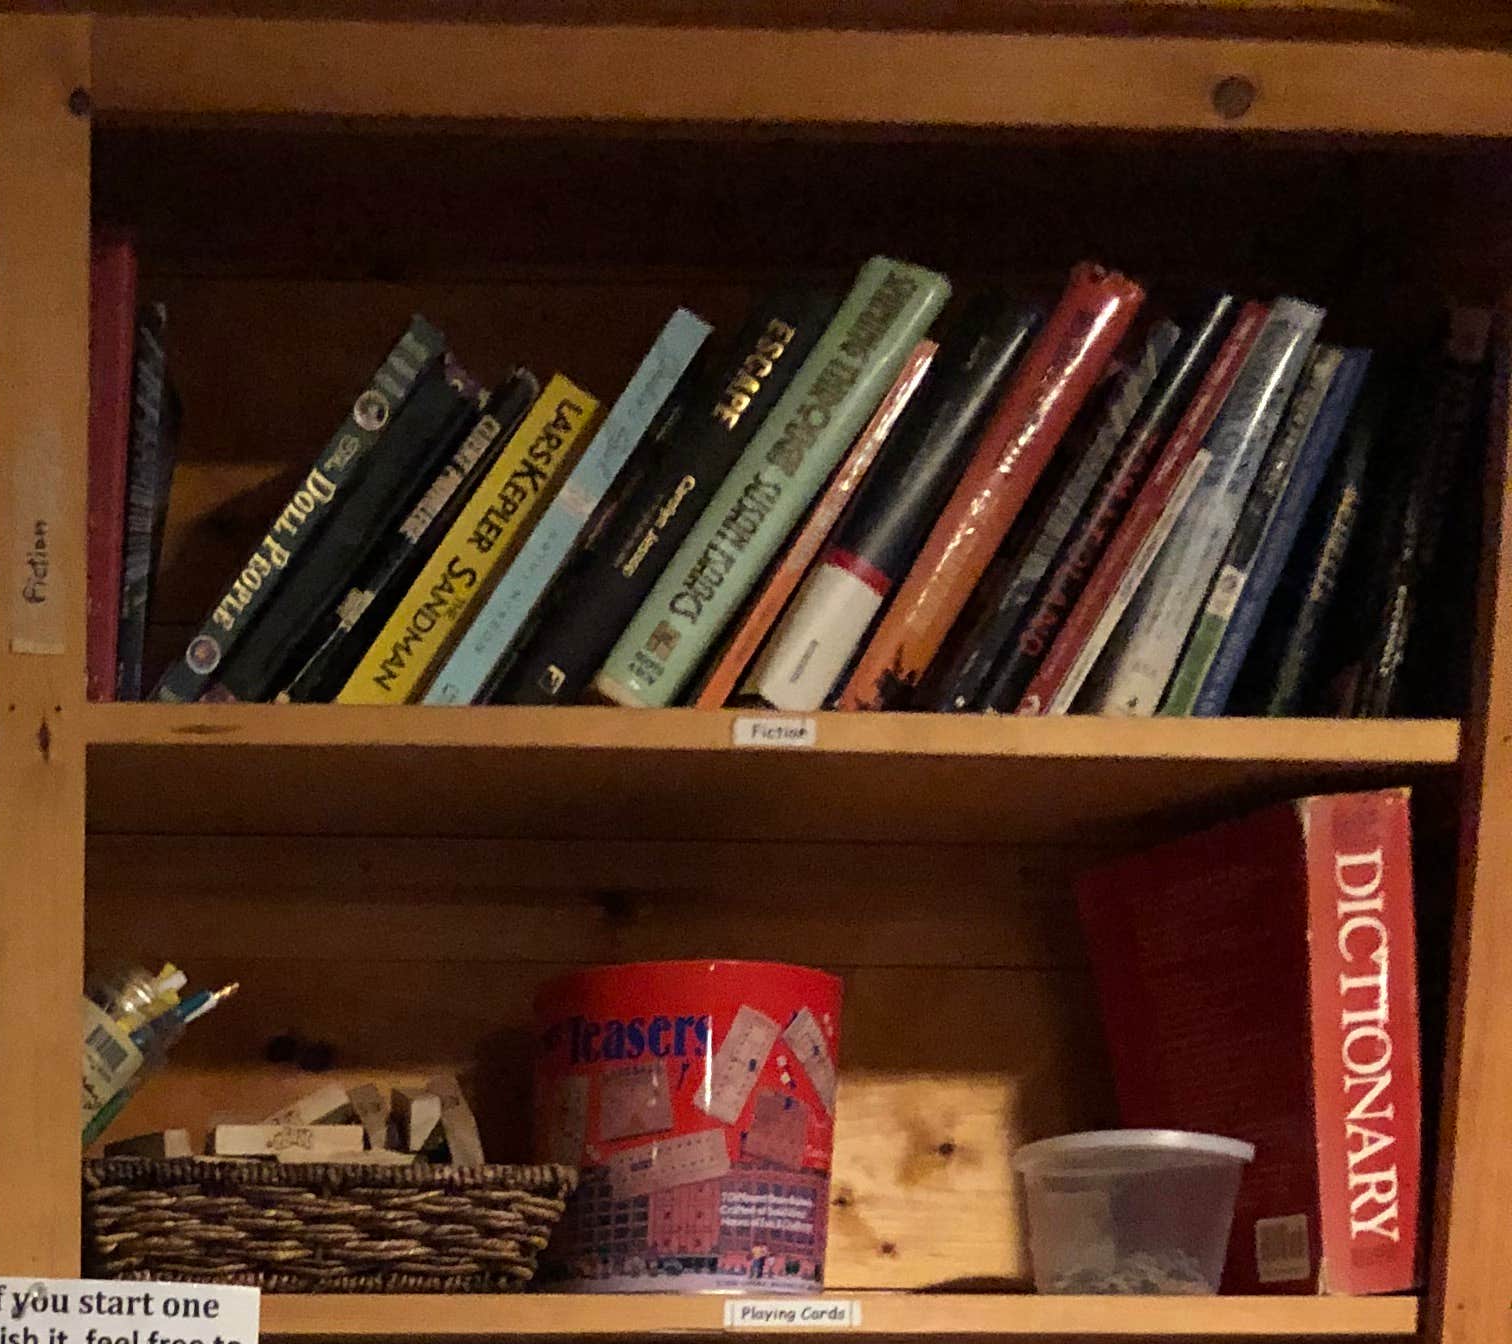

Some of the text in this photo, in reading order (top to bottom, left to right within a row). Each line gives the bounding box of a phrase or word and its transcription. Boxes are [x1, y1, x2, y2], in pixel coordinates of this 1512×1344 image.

[712, 317, 796, 432] ESCAPE
[212, 466, 338, 631] DOLL PEOPLE
[371, 553, 481, 698] SANDMAN
[750, 723, 809, 742] Fiction
[1334, 849, 1400, 1245] DICTIONARY
[11, 1290, 70, 1319] you
[78, 1292, 154, 1317] start
[162, 1298, 221, 1319] one
[741, 1305, 846, 1322] Playing Cards
